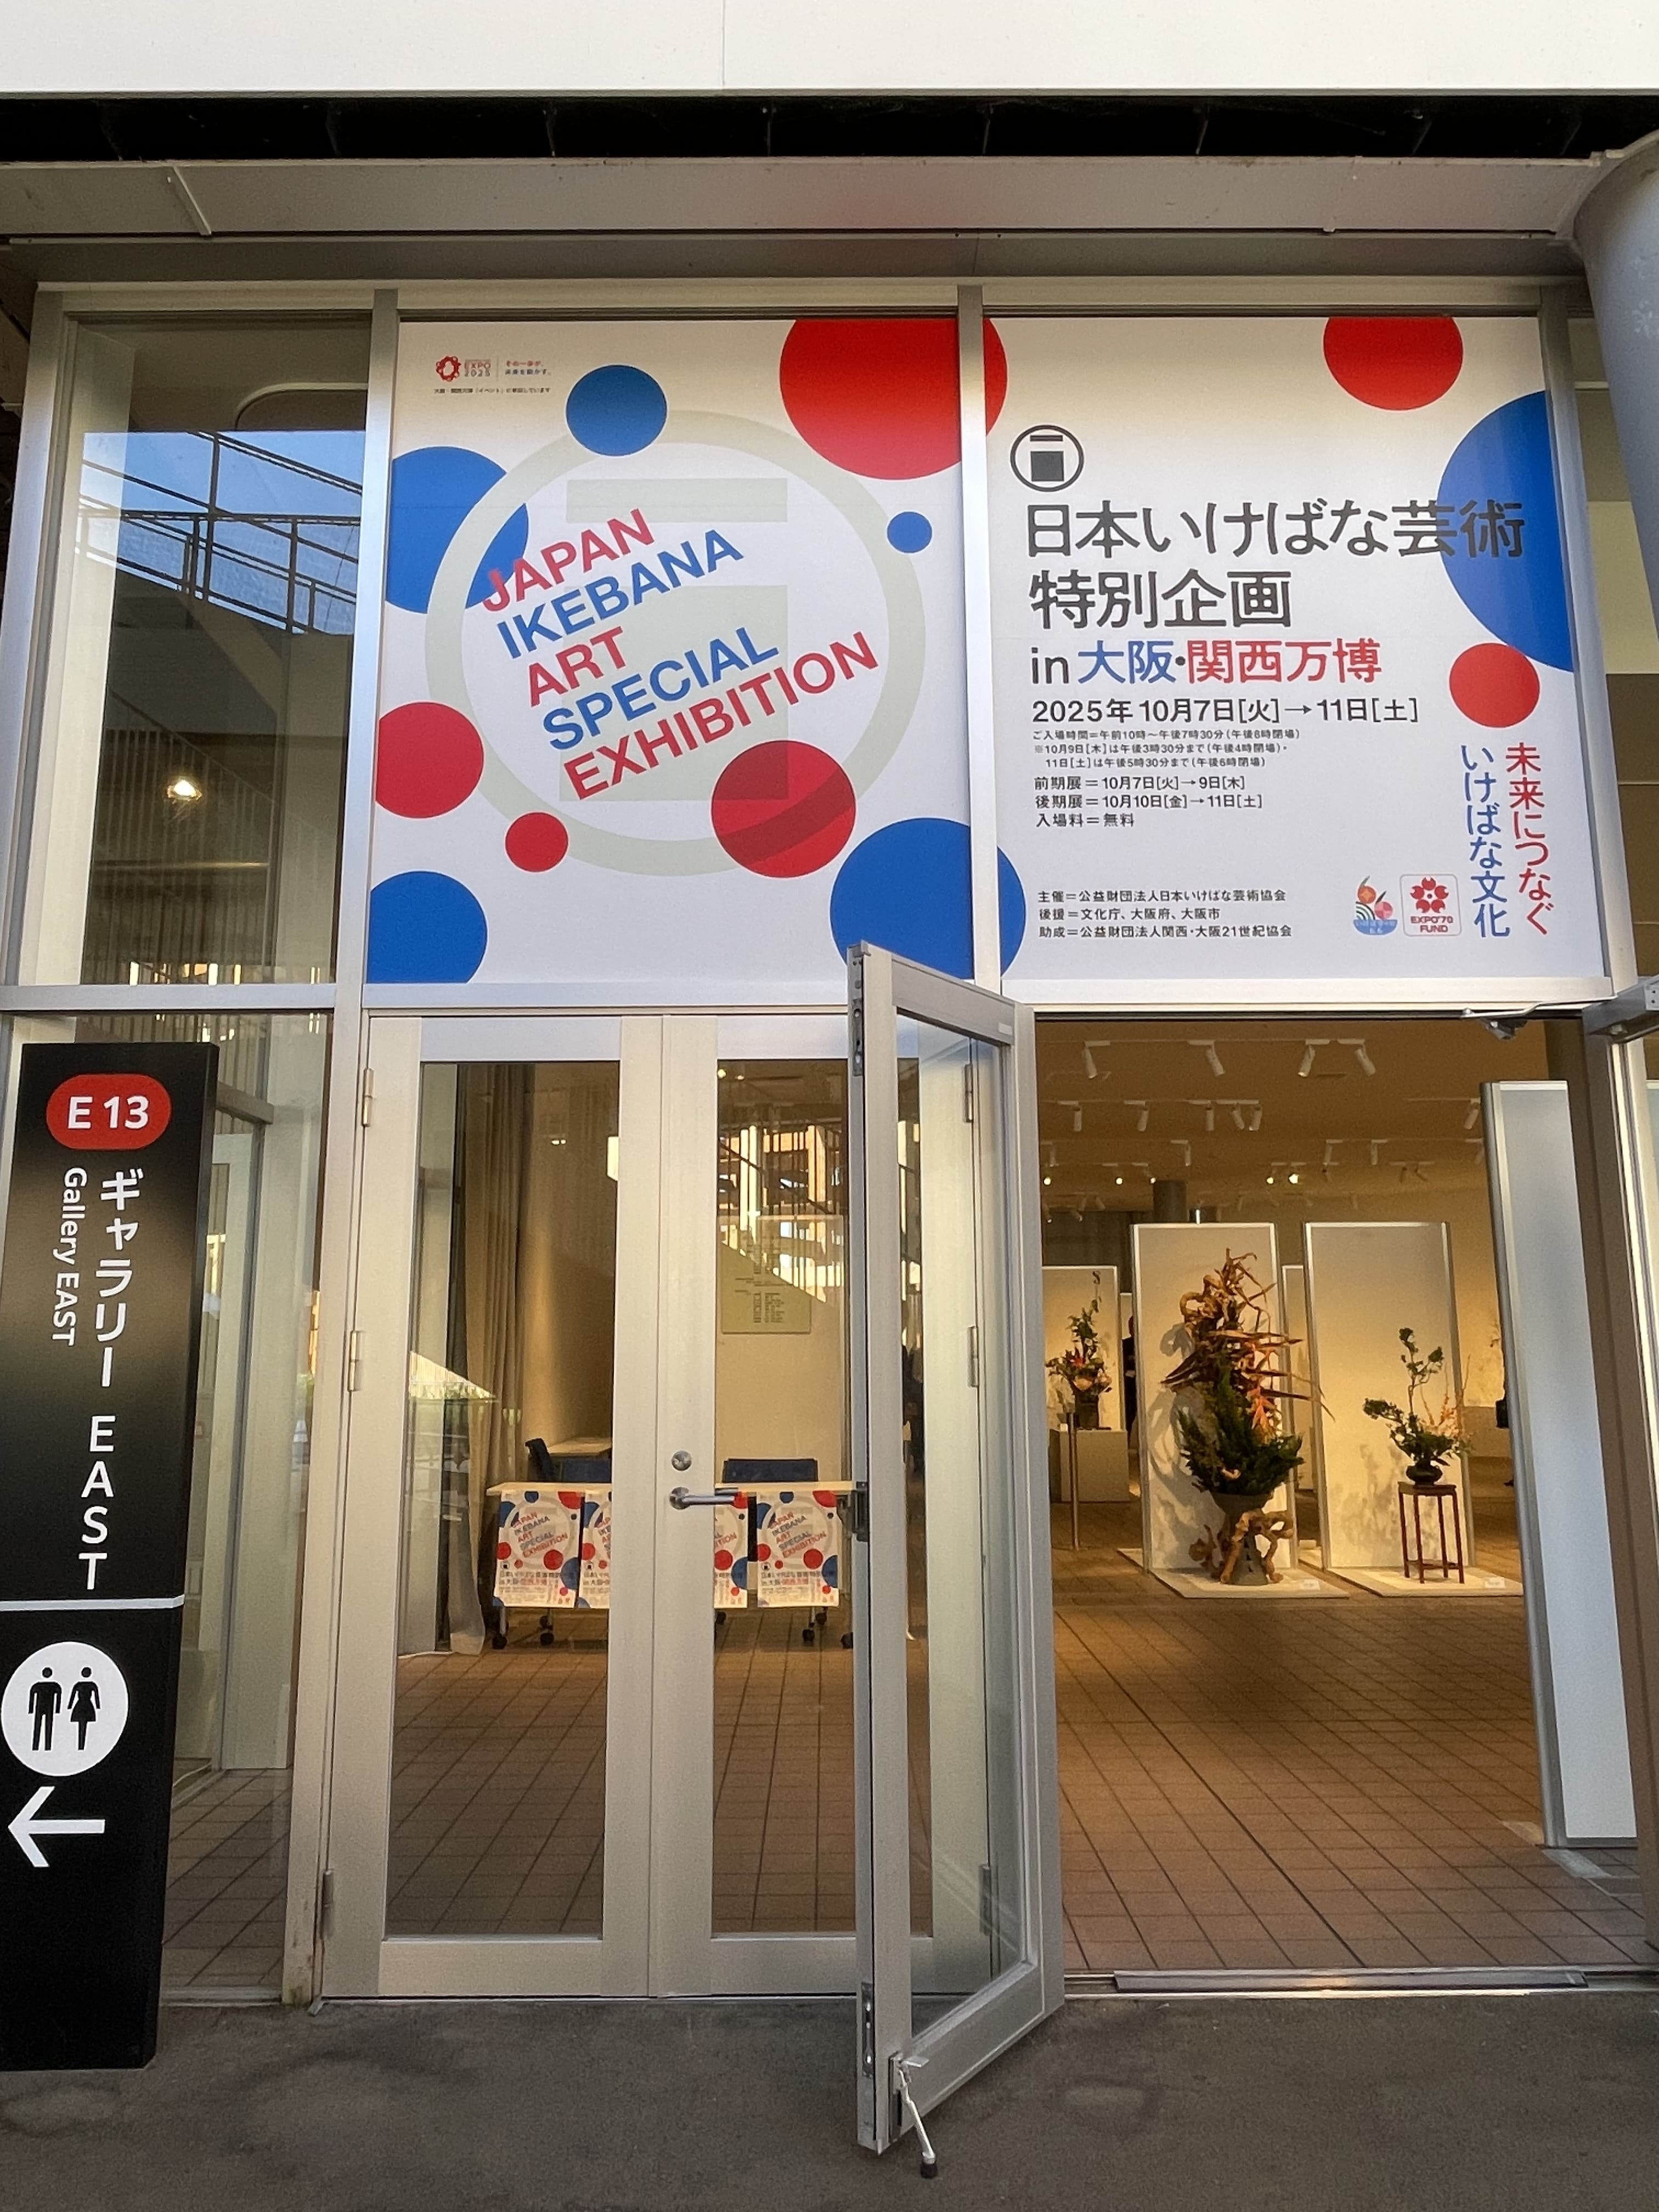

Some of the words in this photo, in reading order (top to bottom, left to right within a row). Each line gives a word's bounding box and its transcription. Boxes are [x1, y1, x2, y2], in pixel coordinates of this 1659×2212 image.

[483, 509, 654, 612] JAPAN
[1026, 498, 1525, 558] 日本いけばな芸術
[496, 530, 744, 659] IKEBANA
[1028, 567, 1292, 629] 特別企画
[527, 625, 627, 707] ART
[543, 627, 780, 750] SPECIAL
[563, 631, 878, 800] EXHIBITION
[1460, 744, 1510, 938] いけばな文化
[1505, 742, 1554, 935] 未来につなぐ
[1420, 924, 1449, 933] FUND
[53, 1167, 89, 1265] Gallery
[52, 1272, 80, 1347] EAST
[95, 1167, 144, 1387] ギャラリー
[78, 1415, 116, 1590] EAST
